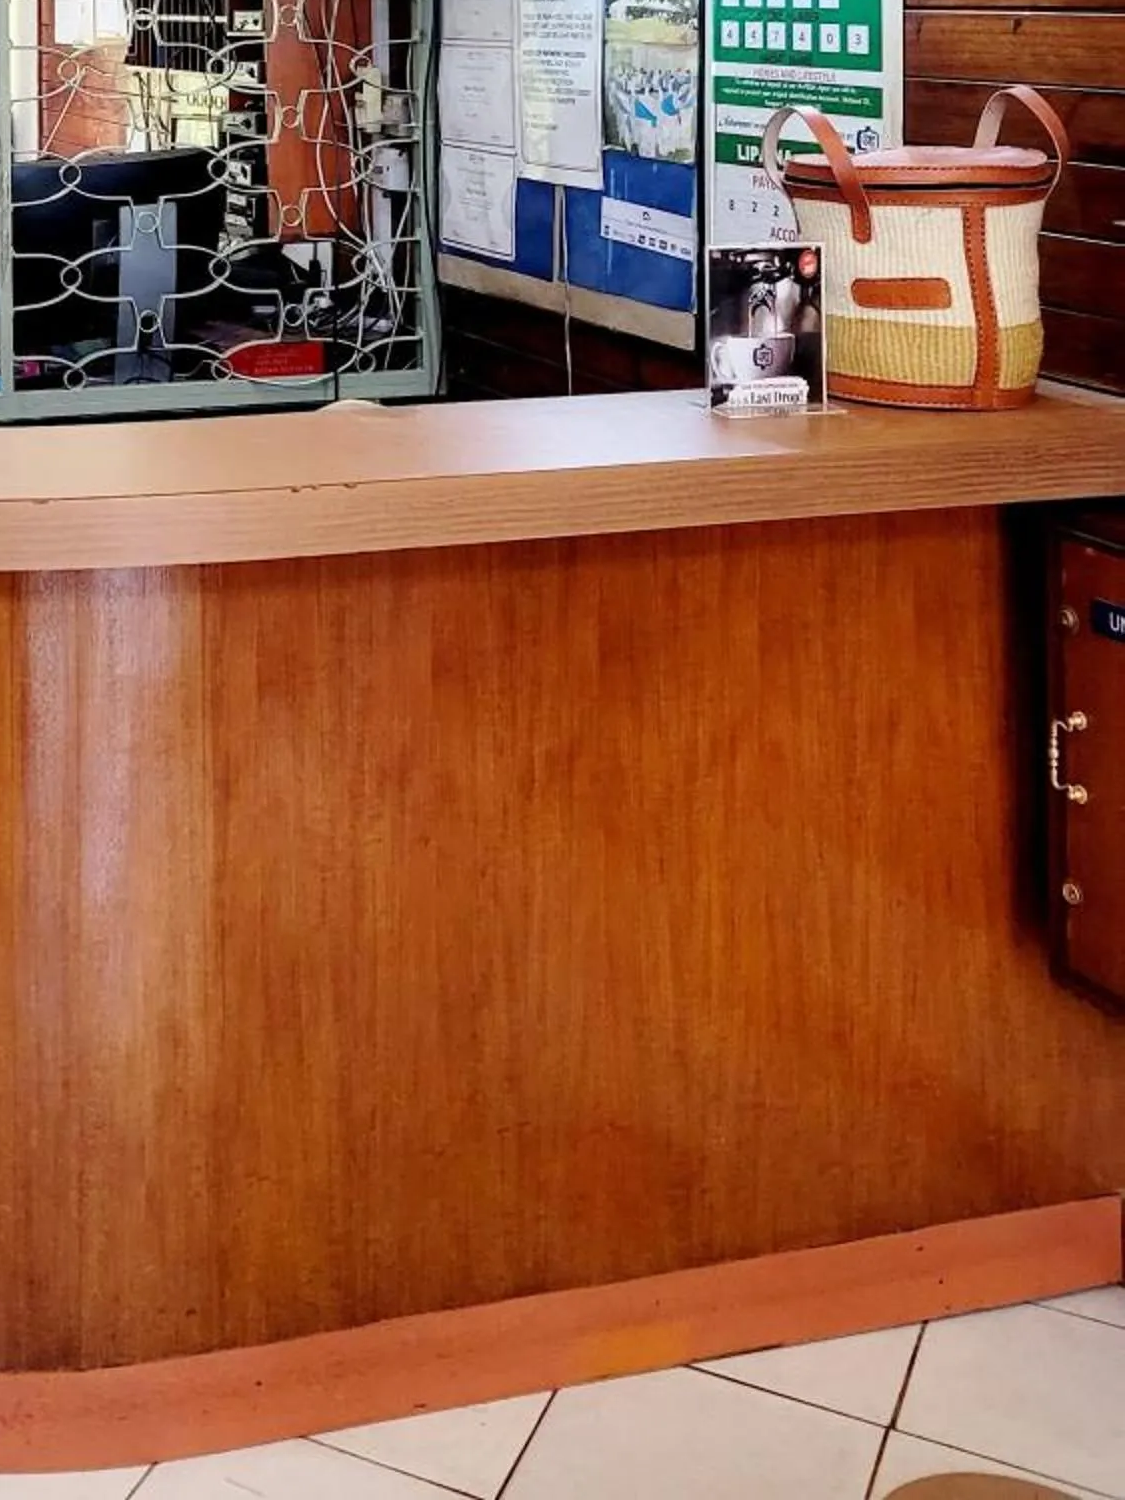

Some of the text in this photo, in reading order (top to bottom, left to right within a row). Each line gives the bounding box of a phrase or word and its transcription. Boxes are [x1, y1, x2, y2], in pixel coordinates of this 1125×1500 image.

[737, 143, 763, 162] LIP
[729, 199, 779, 217] 8 2 2
[770, 227, 796, 242] ACCO
